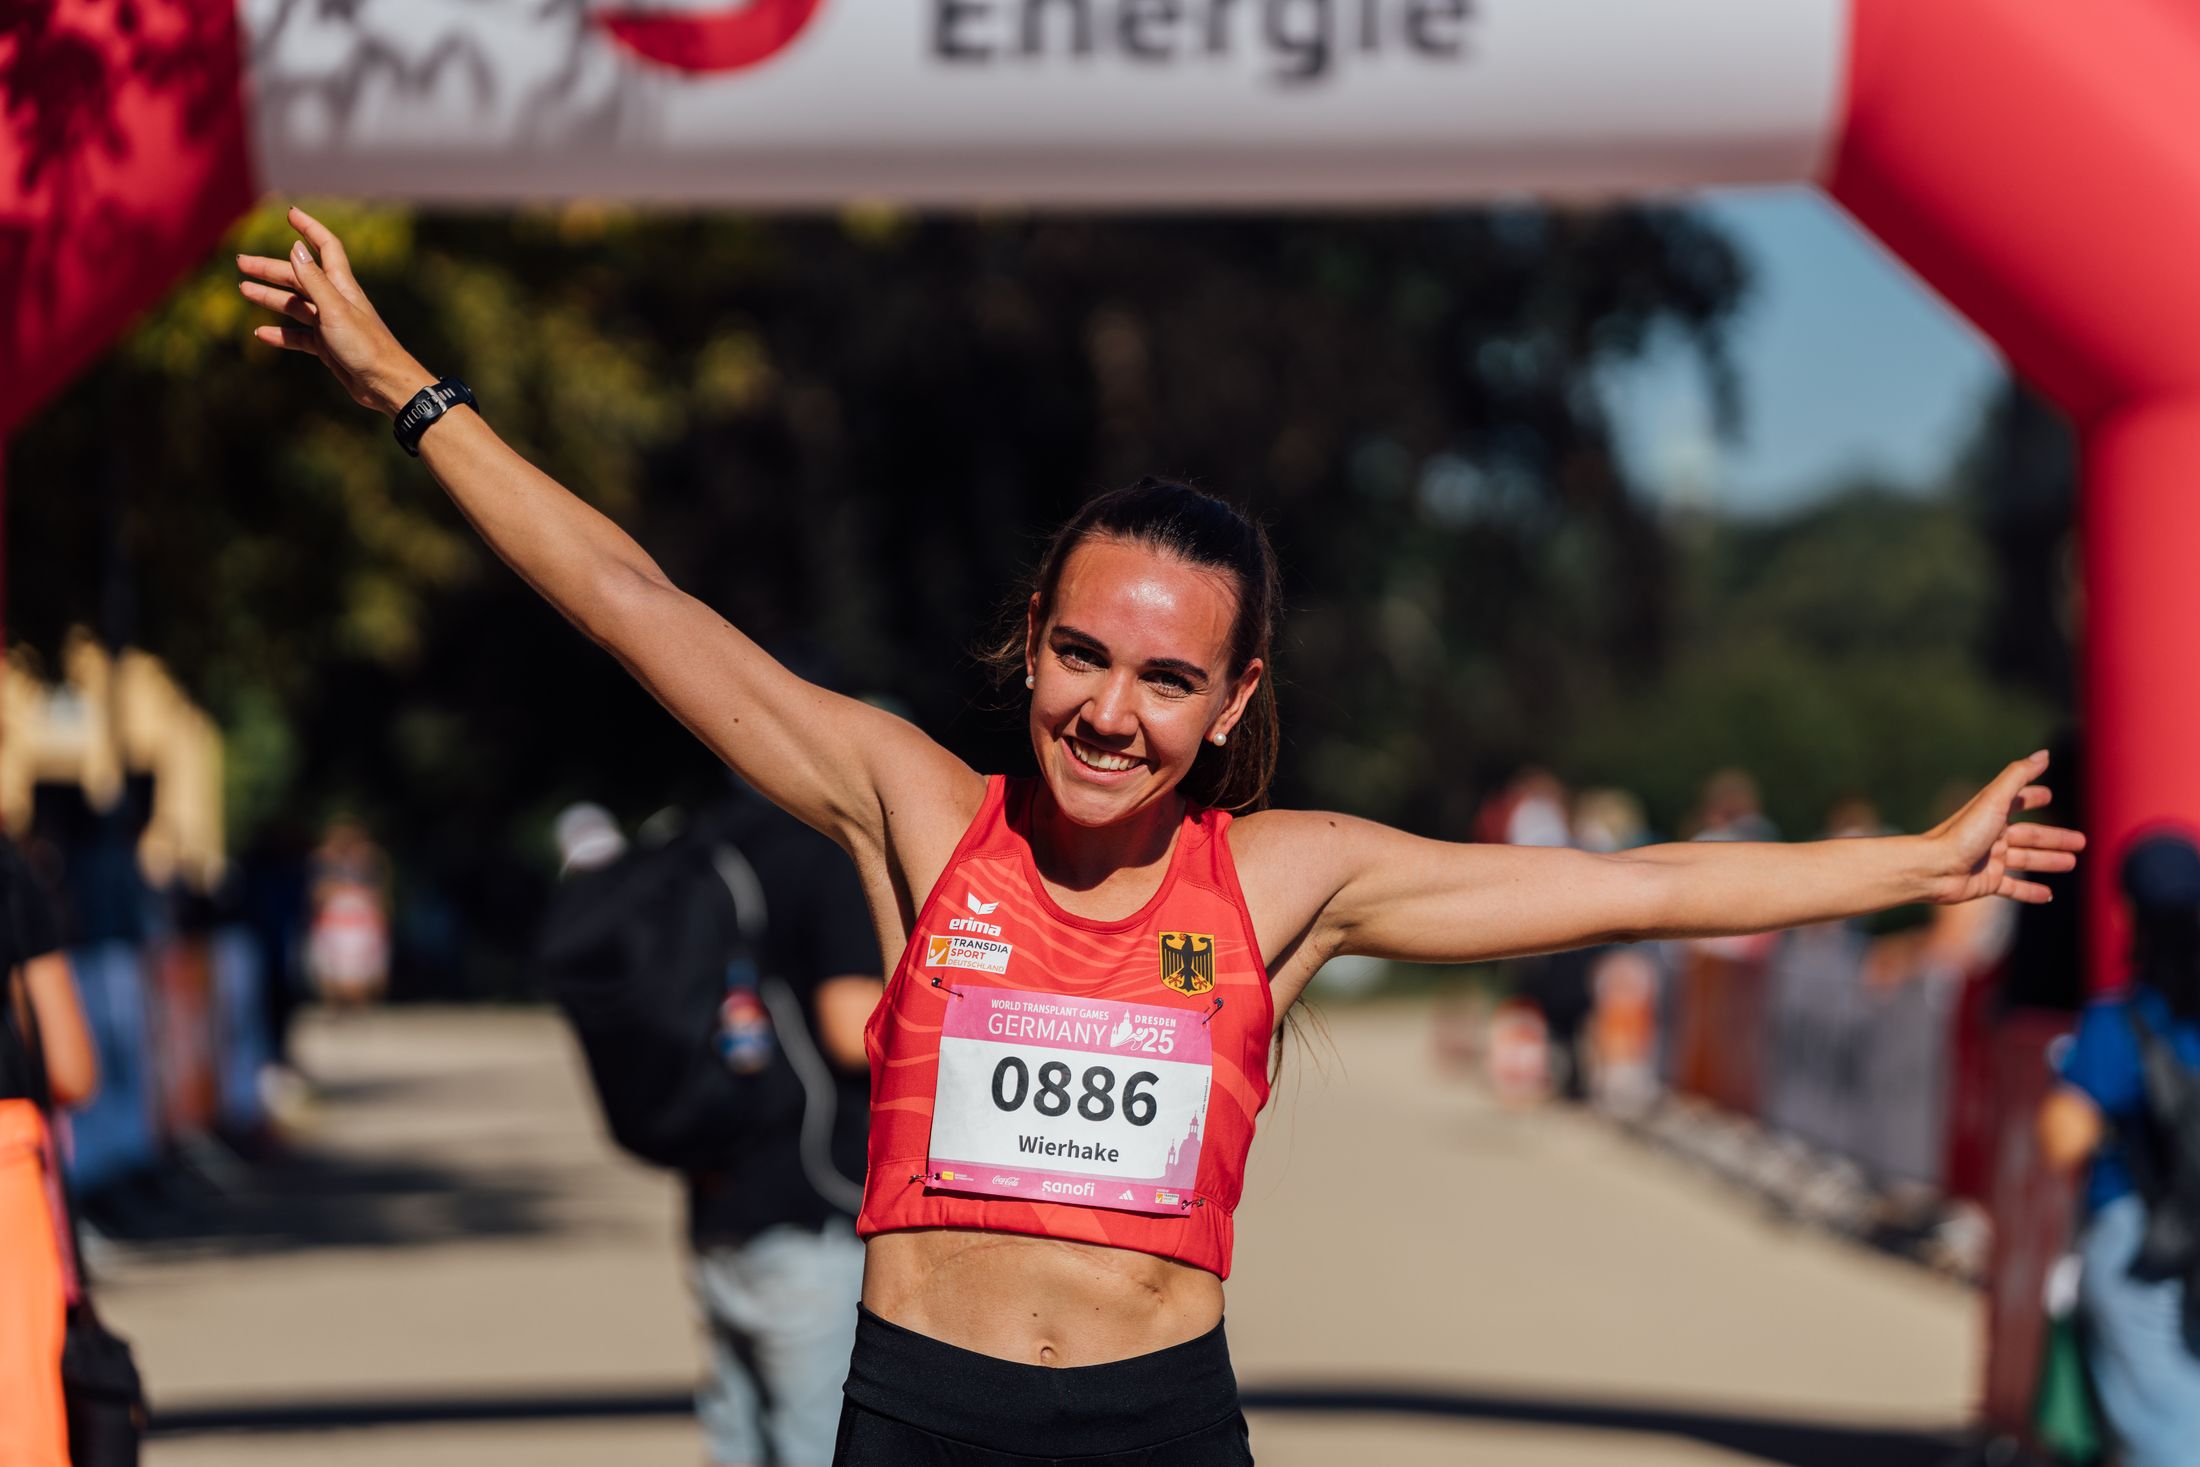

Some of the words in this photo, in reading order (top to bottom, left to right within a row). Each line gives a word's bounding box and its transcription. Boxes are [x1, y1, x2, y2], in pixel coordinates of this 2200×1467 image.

[948, 917, 1002, 937] erima
[950, 948, 986, 960] SPORT
[952, 938, 1009, 954] TRANSDIA
[947, 959, 1005, 973] DEUTSCHLAND
[991, 999, 1021, 1011] WORLD
[1023, 1002, 1078, 1017] TRANSPLANT
[1079, 1009, 1110, 1021] GAMES
[988, 1013, 1107, 1046] GERMANY
[1134, 1014, 1177, 1028] DRESDEN
[991, 1056, 1160, 1127] 0886
[1018, 1134, 1120, 1163] Wierhake
[1041, 1180, 1096, 1197] sanofi
